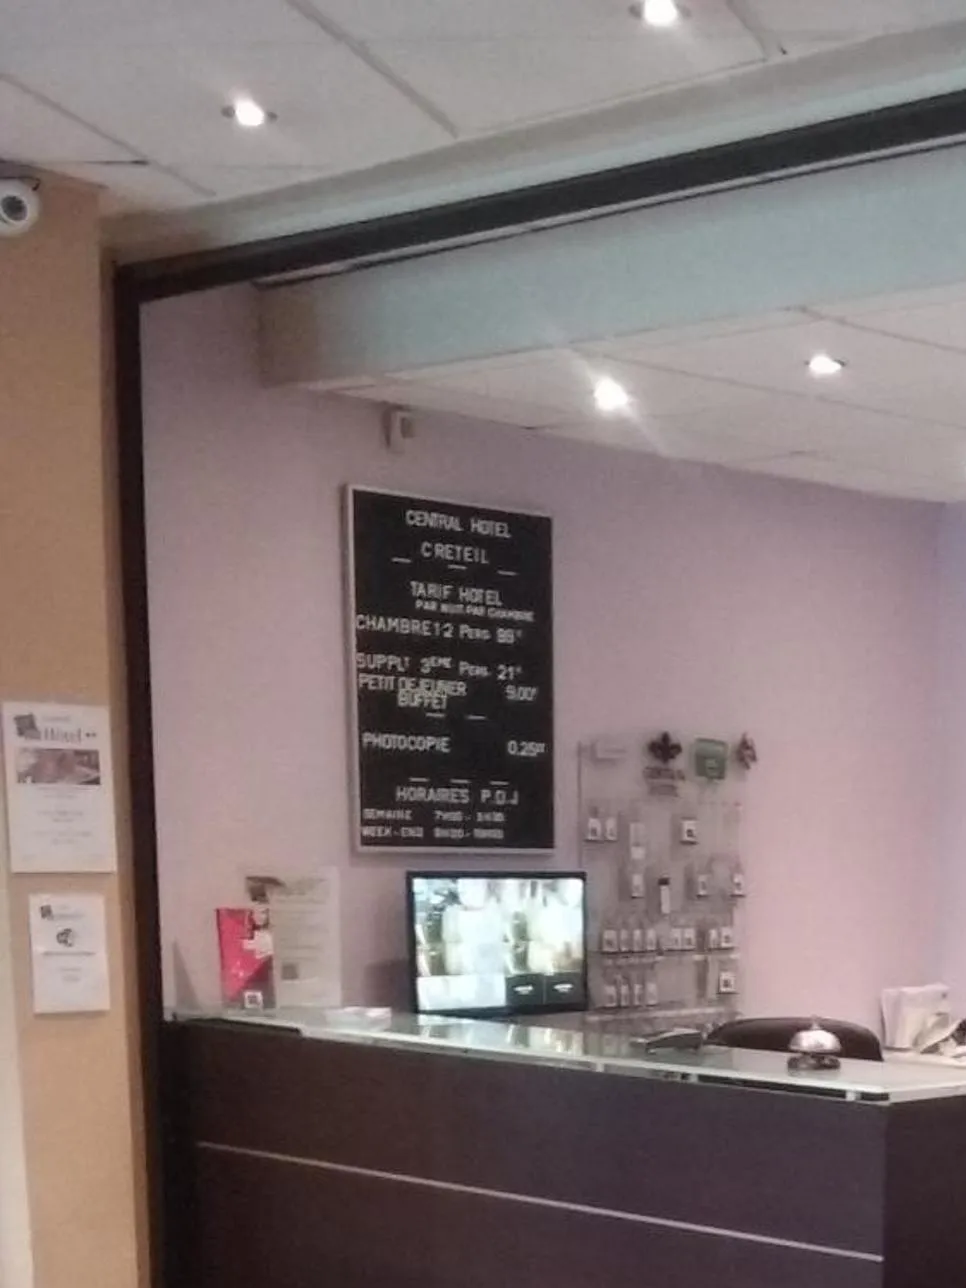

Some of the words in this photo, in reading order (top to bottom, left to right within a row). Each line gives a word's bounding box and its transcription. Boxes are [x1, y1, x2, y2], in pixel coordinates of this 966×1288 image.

[405, 509, 464, 532] CENTRAL
[470, 517, 512, 539] HOTEL
[420, 541, 490, 564] CRETEIL
[410, 580, 453, 600] TARIF
[459, 587, 502, 606] HOTEL
[356, 613, 431, 637] CHAMBRE
[362, 731, 451, 753] PHOTOCOPIE
[395, 785, 470, 805] HORAIRES
